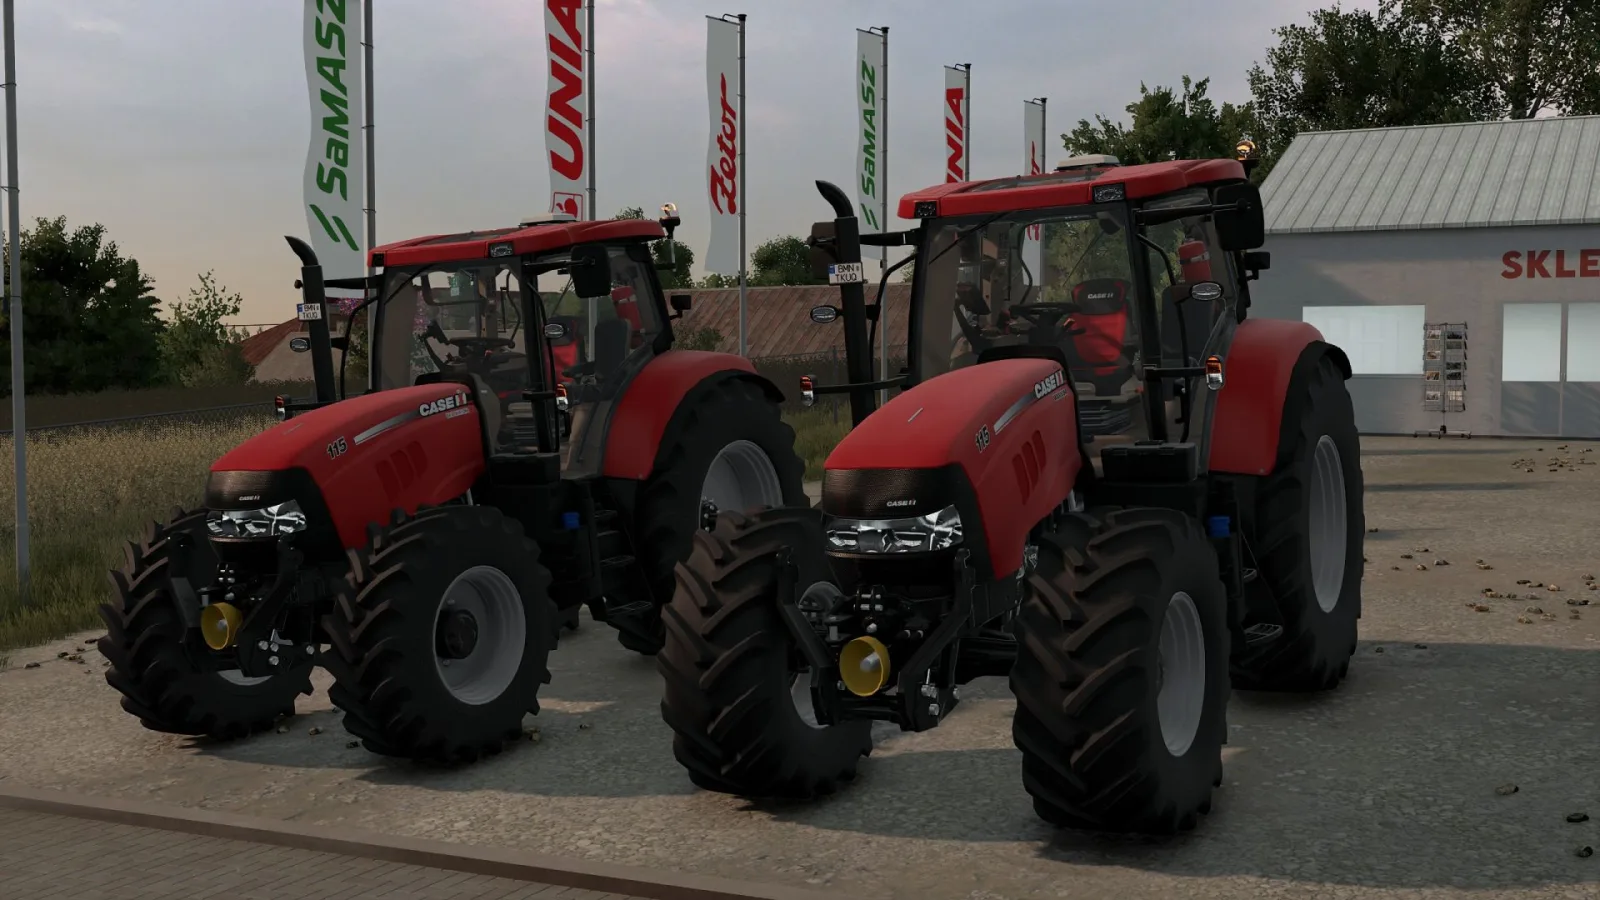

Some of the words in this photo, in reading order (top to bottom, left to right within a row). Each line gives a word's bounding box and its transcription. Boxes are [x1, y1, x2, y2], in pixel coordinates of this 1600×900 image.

[547, 0, 583, 180] UNIA
[710, 73, 736, 214] Zetor
[861, 60, 876, 200] SaMASZ
[1501, 249, 1600, 279] SKLE
[1034, 374, 1057, 399] CASE
[419, 396, 455, 417] CASE
[326, 436, 348, 460] 115
[975, 424, 990, 453] 115
